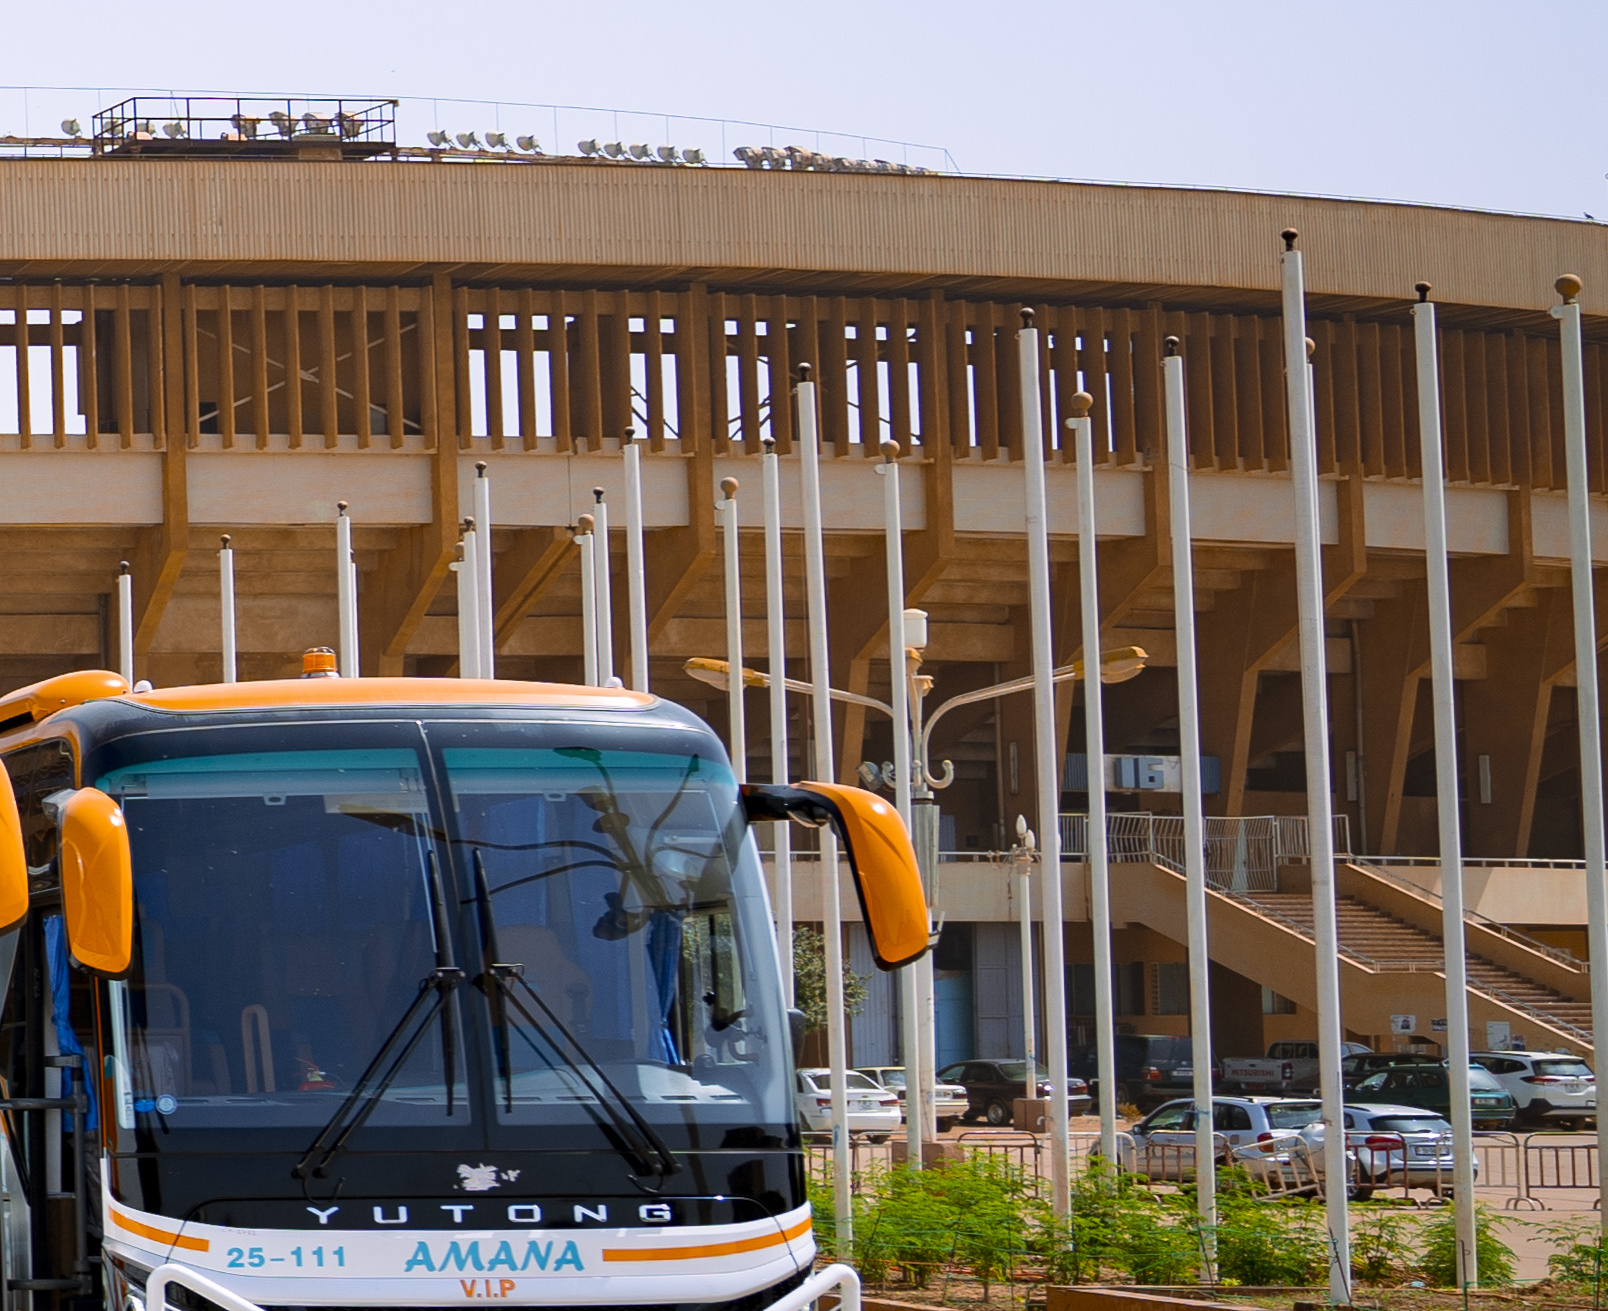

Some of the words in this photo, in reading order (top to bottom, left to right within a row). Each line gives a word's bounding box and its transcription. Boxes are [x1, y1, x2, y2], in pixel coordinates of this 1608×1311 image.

[306, 1204, 674, 1226] YUTONG
[226, 1246, 346, 1269] 25-111
[404, 1240, 586, 1274] AMANA
[460, 1279, 517, 1299] V.I.P
